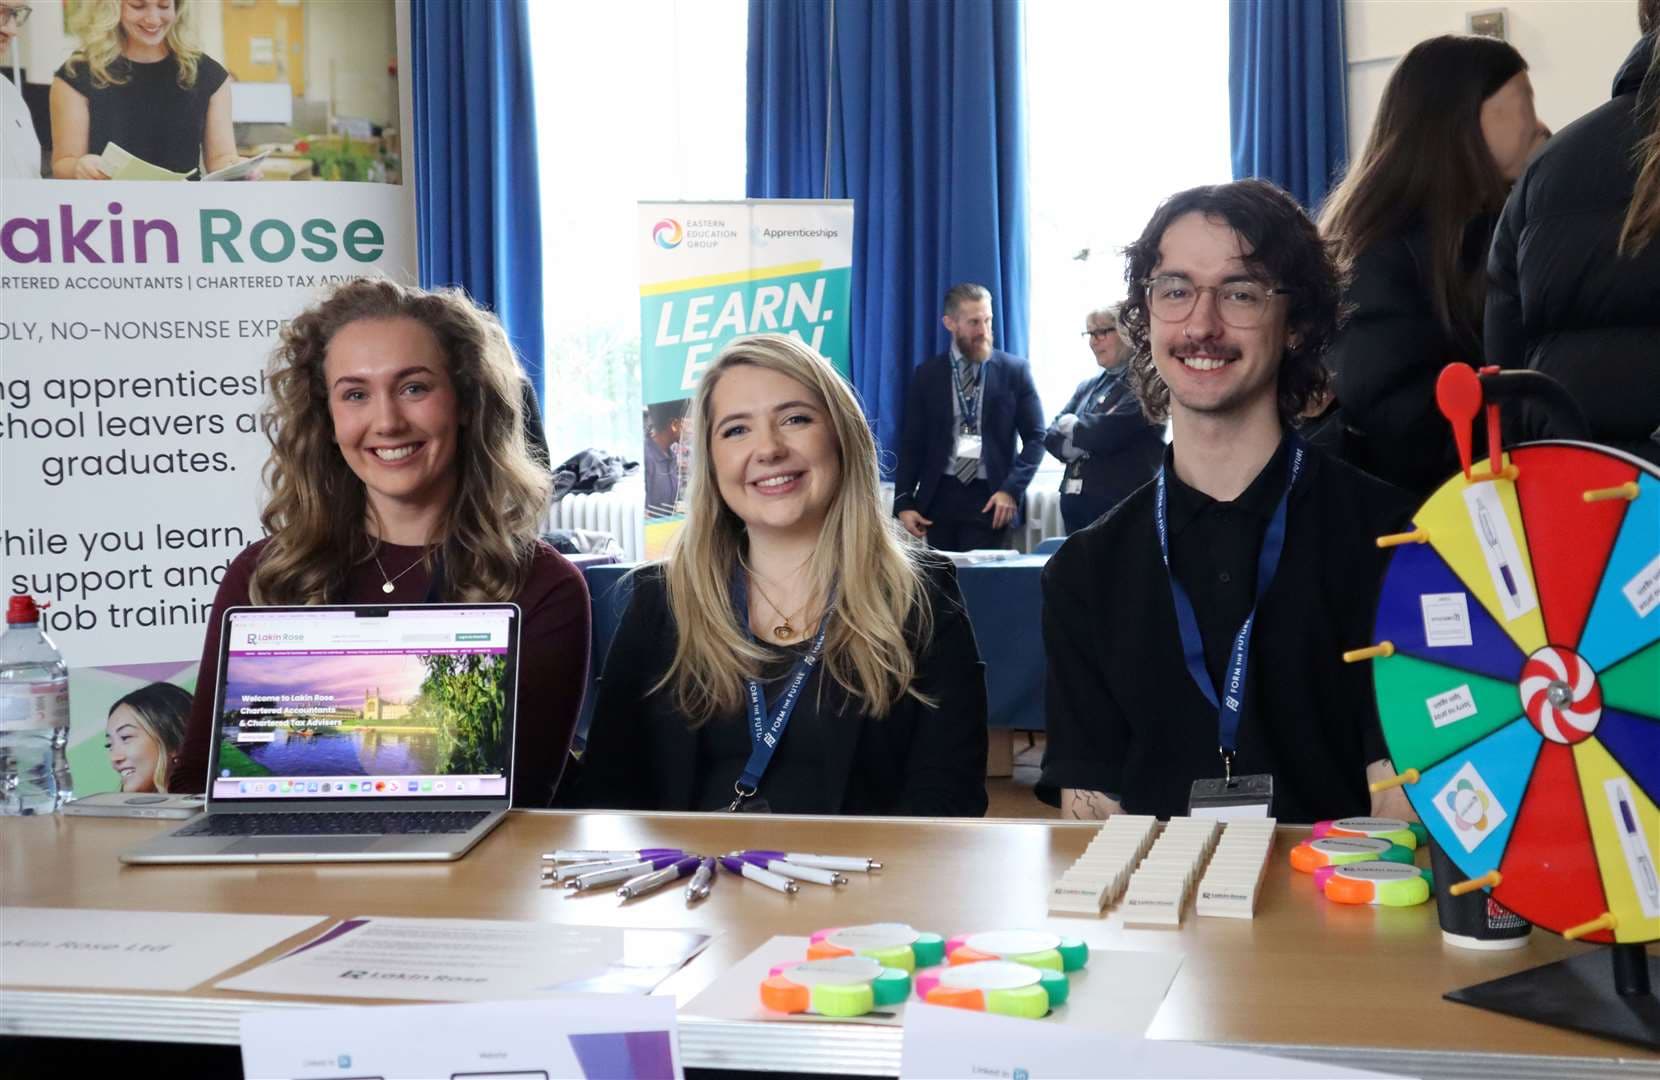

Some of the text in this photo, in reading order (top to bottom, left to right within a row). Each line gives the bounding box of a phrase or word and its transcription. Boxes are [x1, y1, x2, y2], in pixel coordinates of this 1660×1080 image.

[686, 220, 726, 228] EASTERN
[686, 230, 738, 238] EDUCATION
[763, 227, 839, 240] Apprenticeships
[200, 208, 385, 264] Rose
[686, 240, 719, 249] GROUP
[0, 276, 60, 290] RTERED
[64, 276, 184, 290] ACCOUNTANTS
[196, 275, 283, 289] CHARTERED
[287, 275, 315, 288] TAX
[655, 278, 834, 347] LEARN.
[0, 411, 84, 439] hool
[99, 409, 225, 438] leavers
[41, 448, 237, 486] graduates.
[0, 523, 252, 561] hile you learn,
[11, 563, 153, 601] support
[258, 633, 305, 641] Lakin Rose
[1230, 668, 1242, 694] FORM
[241, 694, 281, 702] Welcome
[291, 694, 313, 702] Lakin
[770, 672, 806, 733] FORM THE FUTURE
[240, 706, 337, 715] Chartered Accountants
[239, 719, 246, 728] &
[247, 719, 289, 728] Chartered
[290, 719, 306, 727] Tax
[753, 716, 763, 742] FUTU
